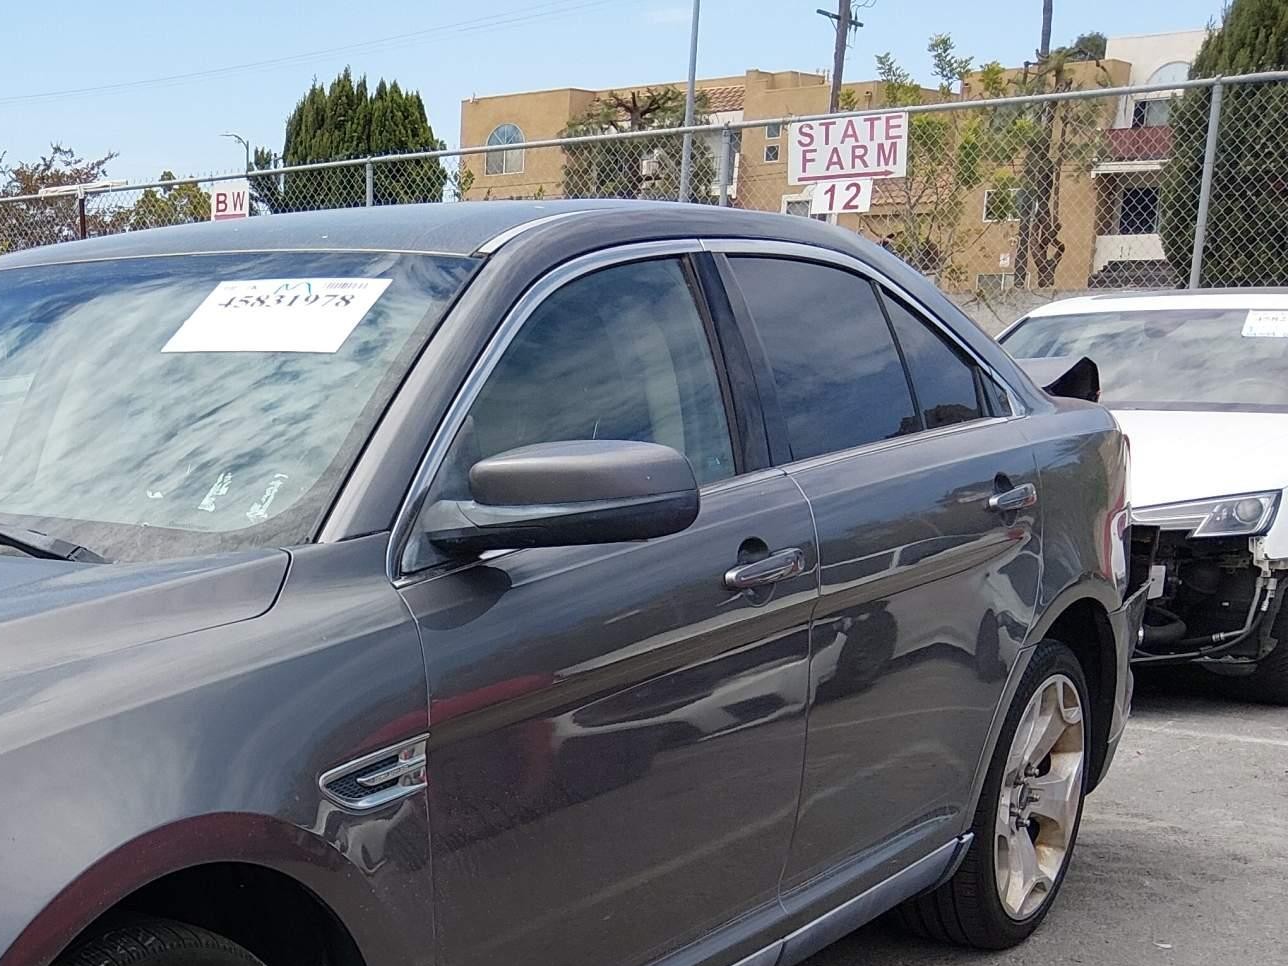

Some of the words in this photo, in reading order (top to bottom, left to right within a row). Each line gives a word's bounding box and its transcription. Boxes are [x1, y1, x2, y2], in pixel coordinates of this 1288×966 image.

[797, 114, 903, 148] STATE
[801, 141, 898, 173] FARM
[823, 182, 862, 211] 12
[218, 294, 355, 308] 45831978
